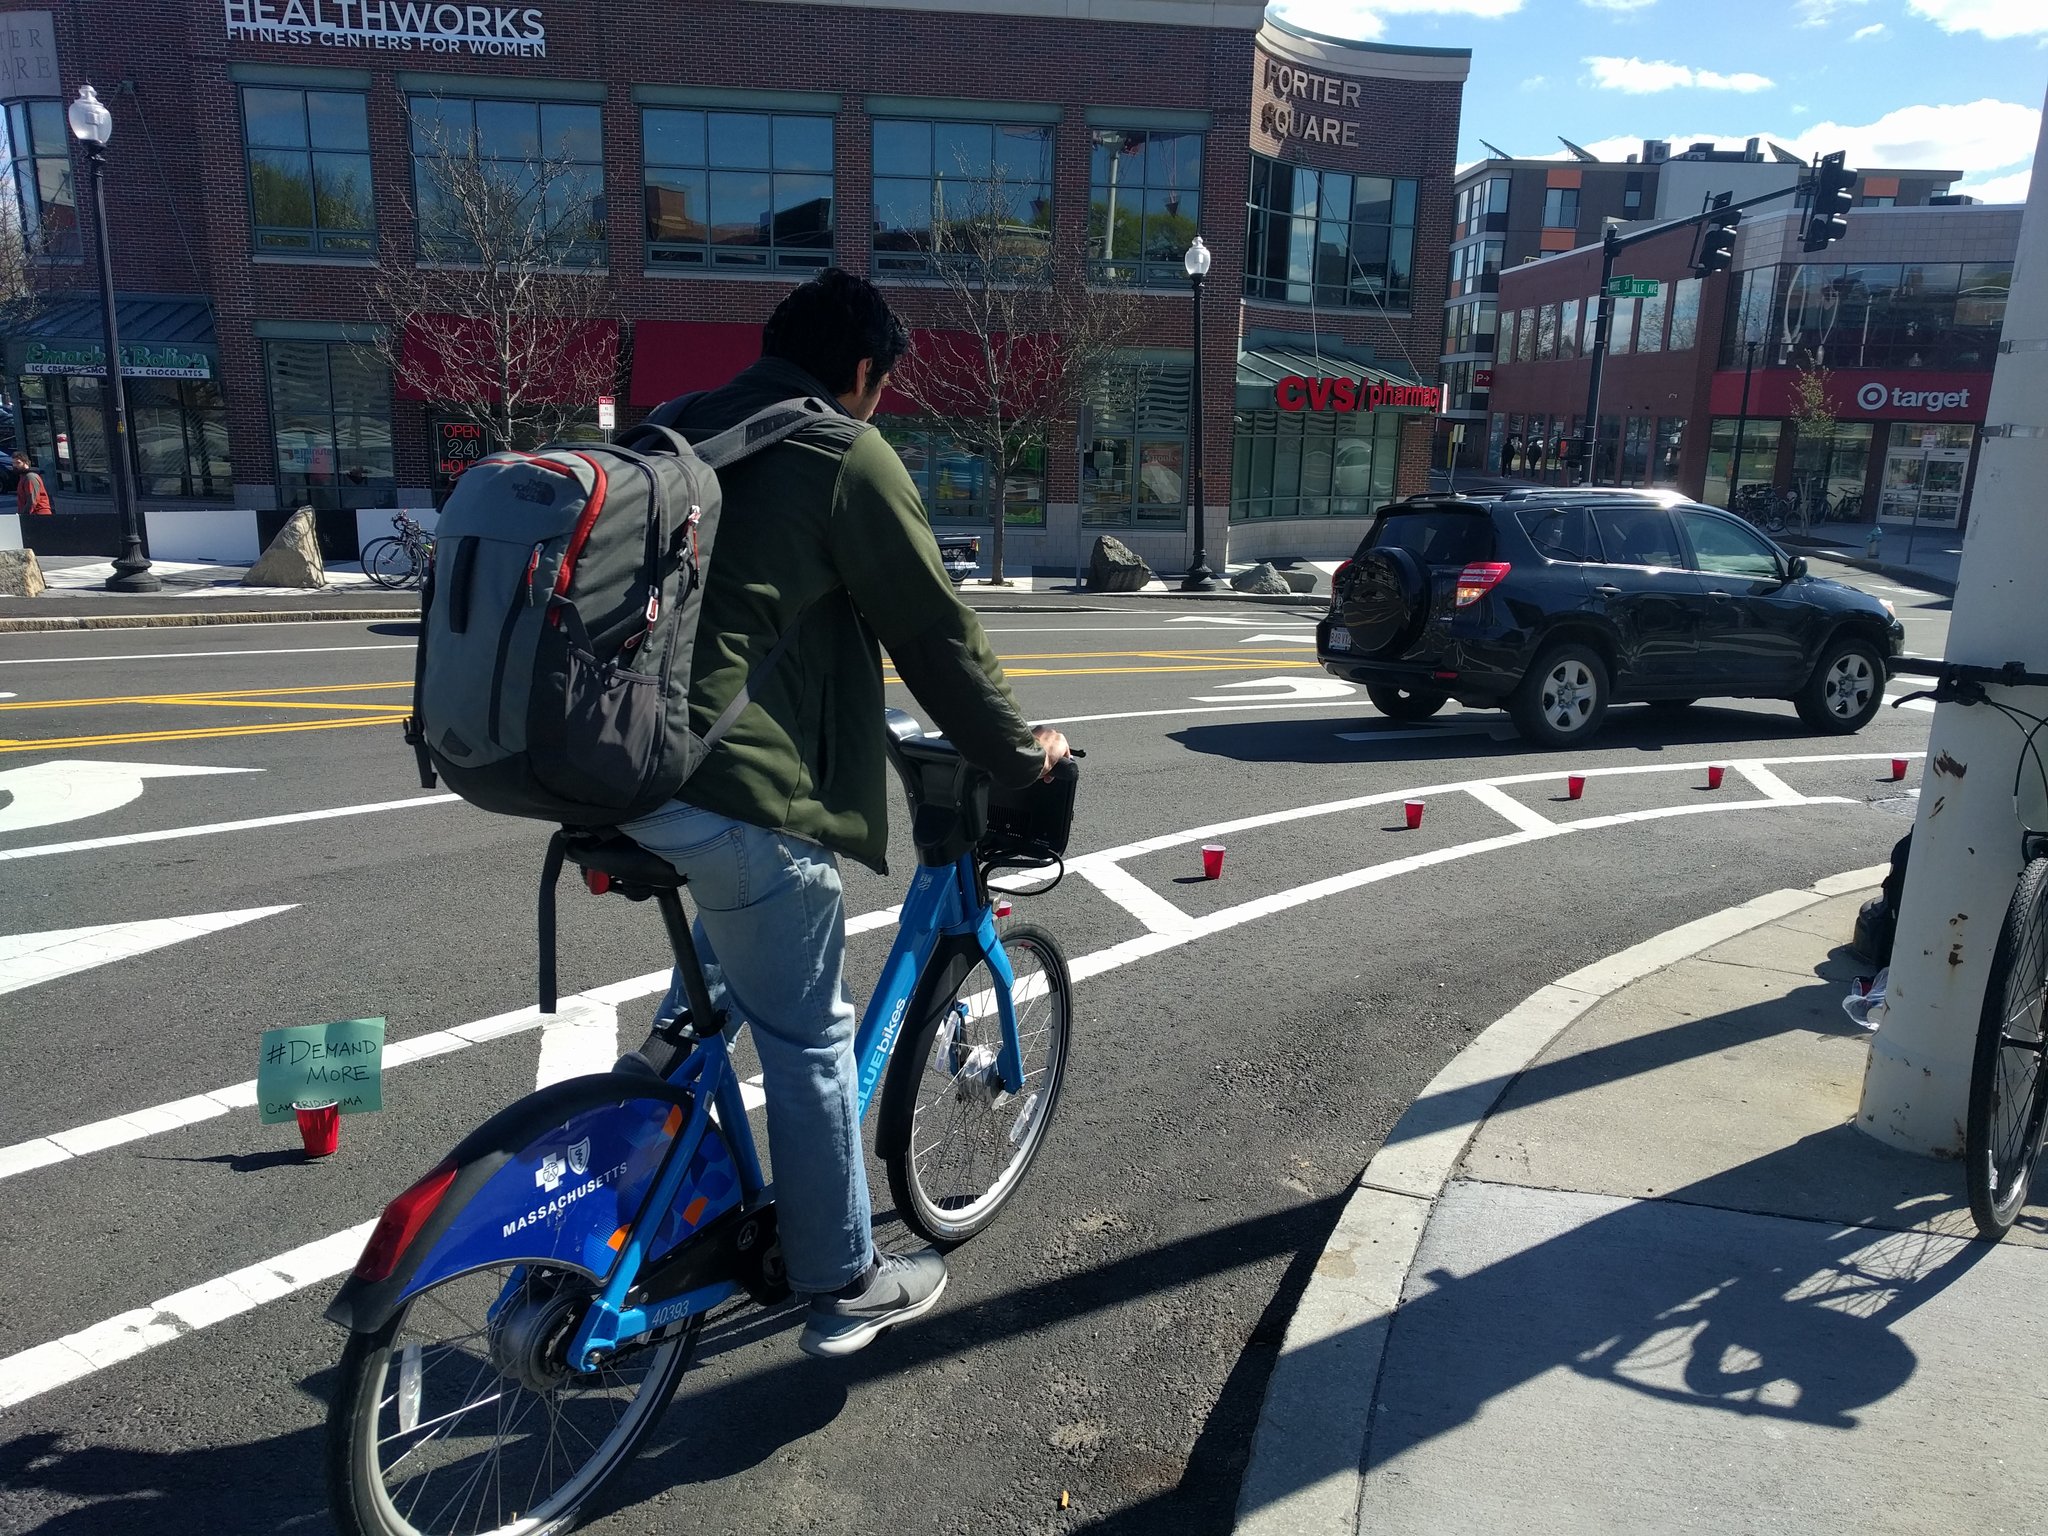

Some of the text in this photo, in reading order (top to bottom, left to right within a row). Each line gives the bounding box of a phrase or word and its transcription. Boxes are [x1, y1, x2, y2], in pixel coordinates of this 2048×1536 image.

[225, 0, 545, 40] HEALTHWORKS
[227, 26, 546, 58] FITNESS CENTERS FOR WOMEN
[1268, 59, 1361, 108] PORTER
[1263, 102, 1360, 147] SQUARE
[1648, 284, 1658, 293] AVE
[31, 364, 43, 372] ICE
[145, 369, 203, 377] CHOCOLATES
[1891, 388, 1970, 412] target
[444, 424, 480, 438] OPEN
[447, 438, 480, 459] 24
[266, 1040, 376, 1065] #DEMAND
[306, 1065, 369, 1085] MORE
[343, 1096, 362, 1106] MA
[503, 1162, 627, 1237] MASSACHUSETTS
